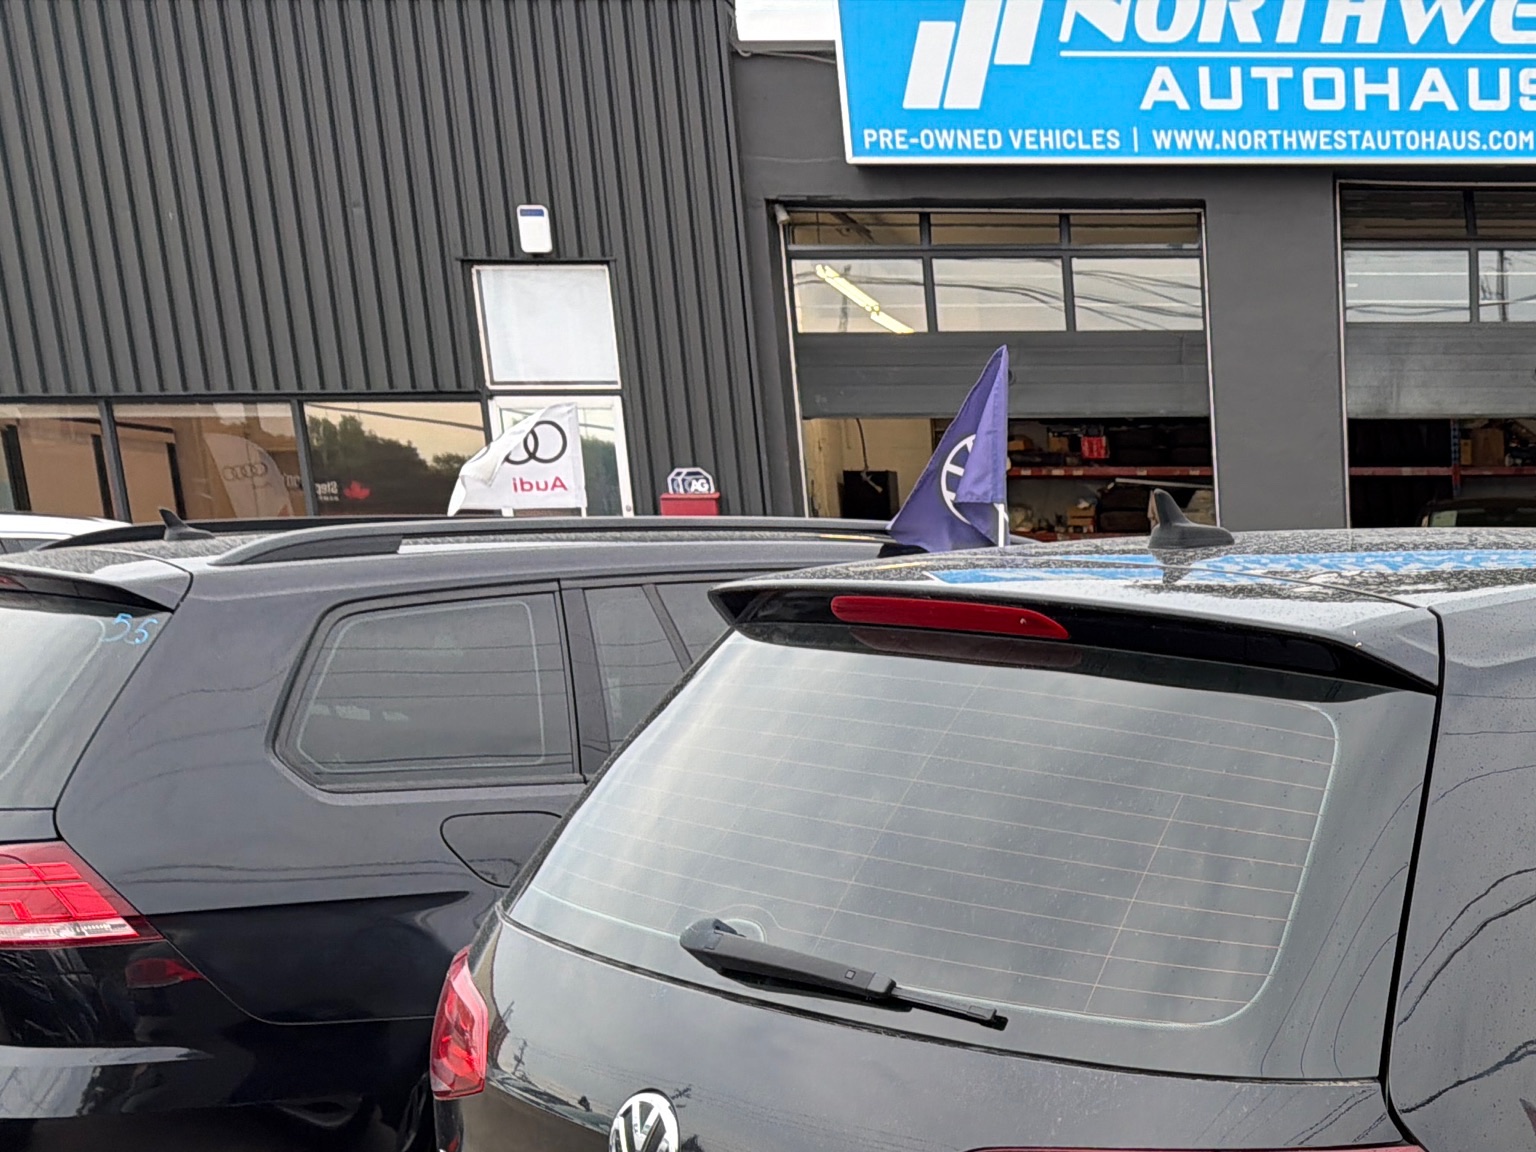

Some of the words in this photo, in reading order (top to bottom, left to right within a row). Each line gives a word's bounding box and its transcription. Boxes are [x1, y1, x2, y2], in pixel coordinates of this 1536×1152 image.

[863, 129, 1003, 150] PRE-OWNED
[1009, 129, 1120, 150] VEHICLES
[1151, 129, 1535, 151] WWW.NORTHWESTAUTOHAUS.COM
